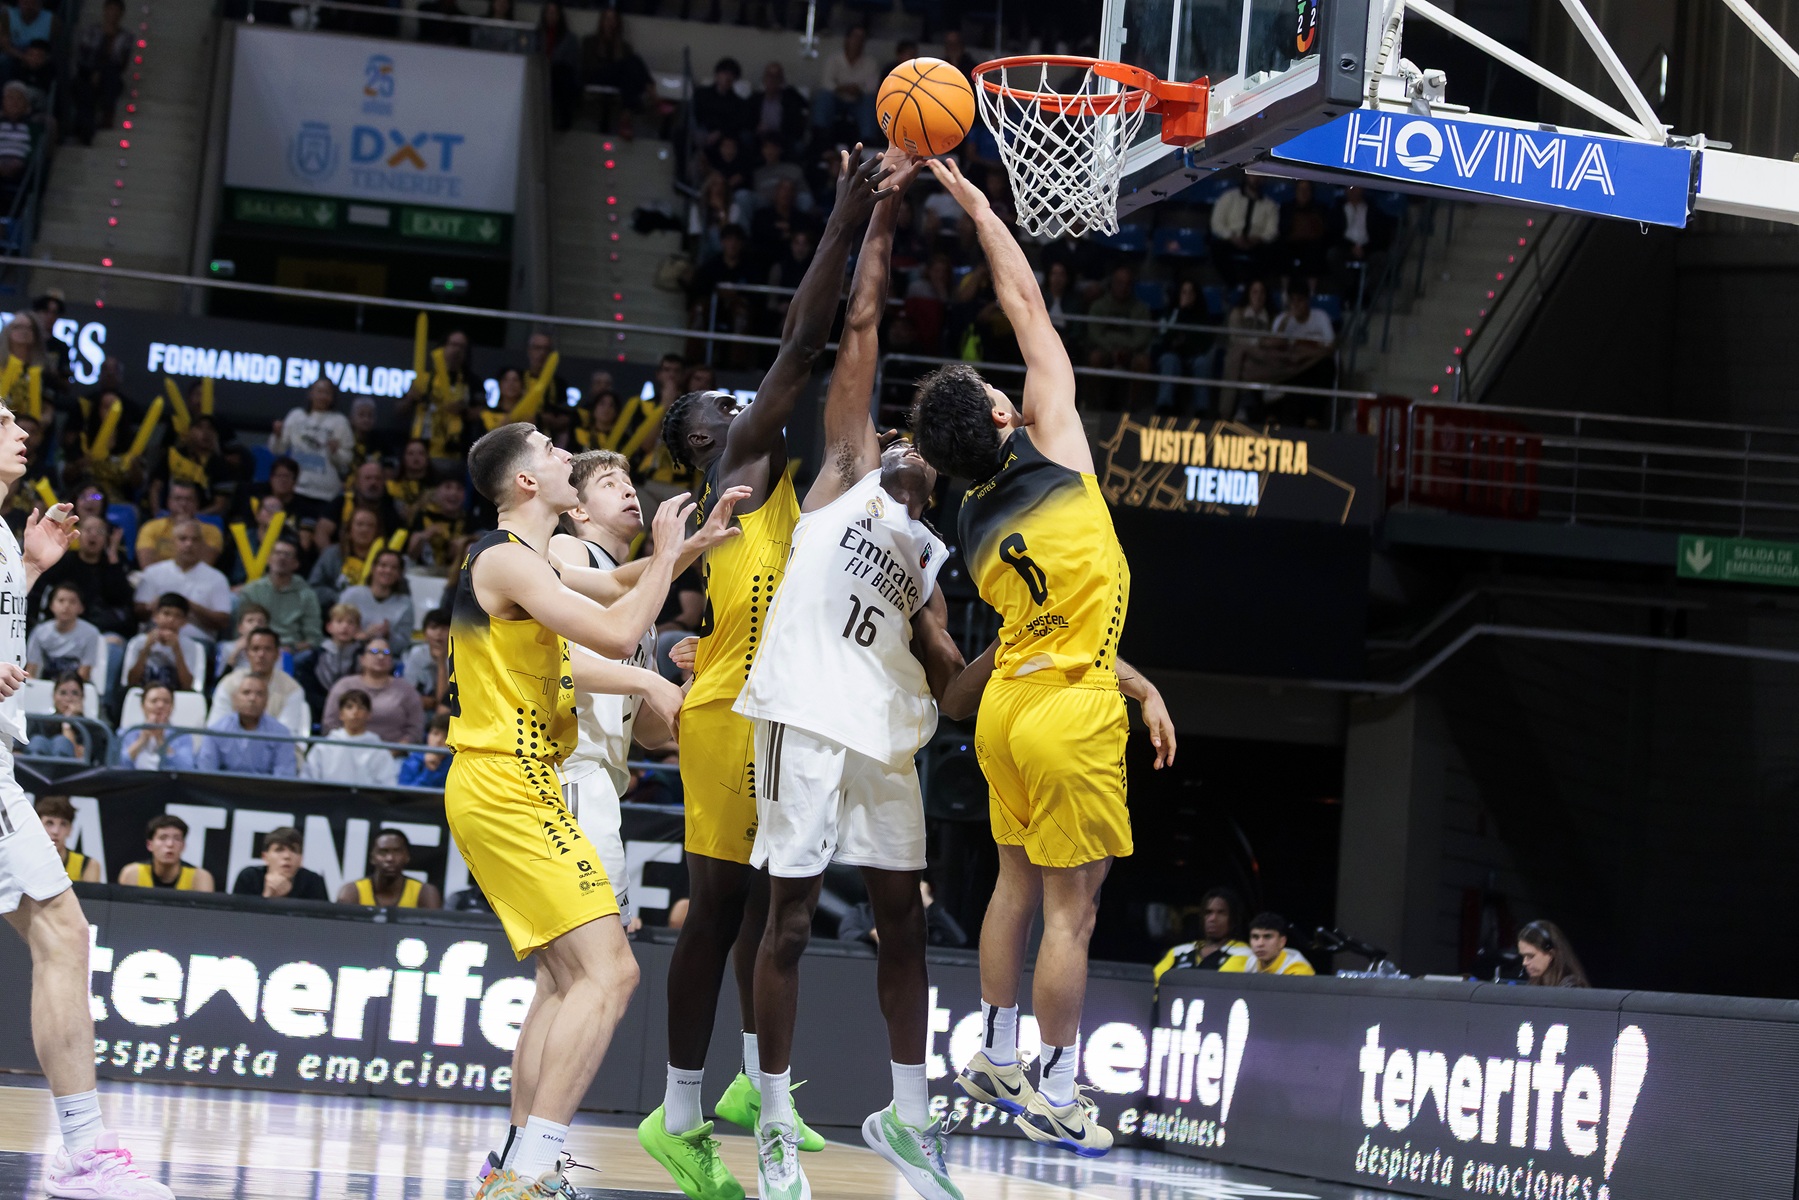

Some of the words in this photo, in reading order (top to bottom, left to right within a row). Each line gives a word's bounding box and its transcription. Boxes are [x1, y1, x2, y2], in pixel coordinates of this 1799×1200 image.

[351, 125, 465, 171] DXT
[1343, 112, 1615, 196] HOVIMA
[351, 168, 461, 198] TENERIFE
[412, 214, 463, 236] EXIT
[147, 342, 282, 385] FORMANDO
[285, 356, 320, 388] EN
[1139, 427, 1207, 466] VISITA
[1212, 433, 1308, 475] NUESTRA
[1184, 465, 1259, 506] TIENDA
[840, 526, 919, 612] Emirates
[844, 556, 873, 579] FLY
[999, 532, 1048, 607] 6
[1734, 546, 1775, 562] SALIDA
[1778, 549, 1793, 563] DE
[842, 593, 885, 648] 16
[94, 1033, 279, 1075] espierta
[298, 1051, 513, 1092] emocione
[1359, 1020, 1650, 1199] tenerife!
[1355, 1133, 1454, 1185] despierta
[1462, 1157, 1593, 1200] emociones
